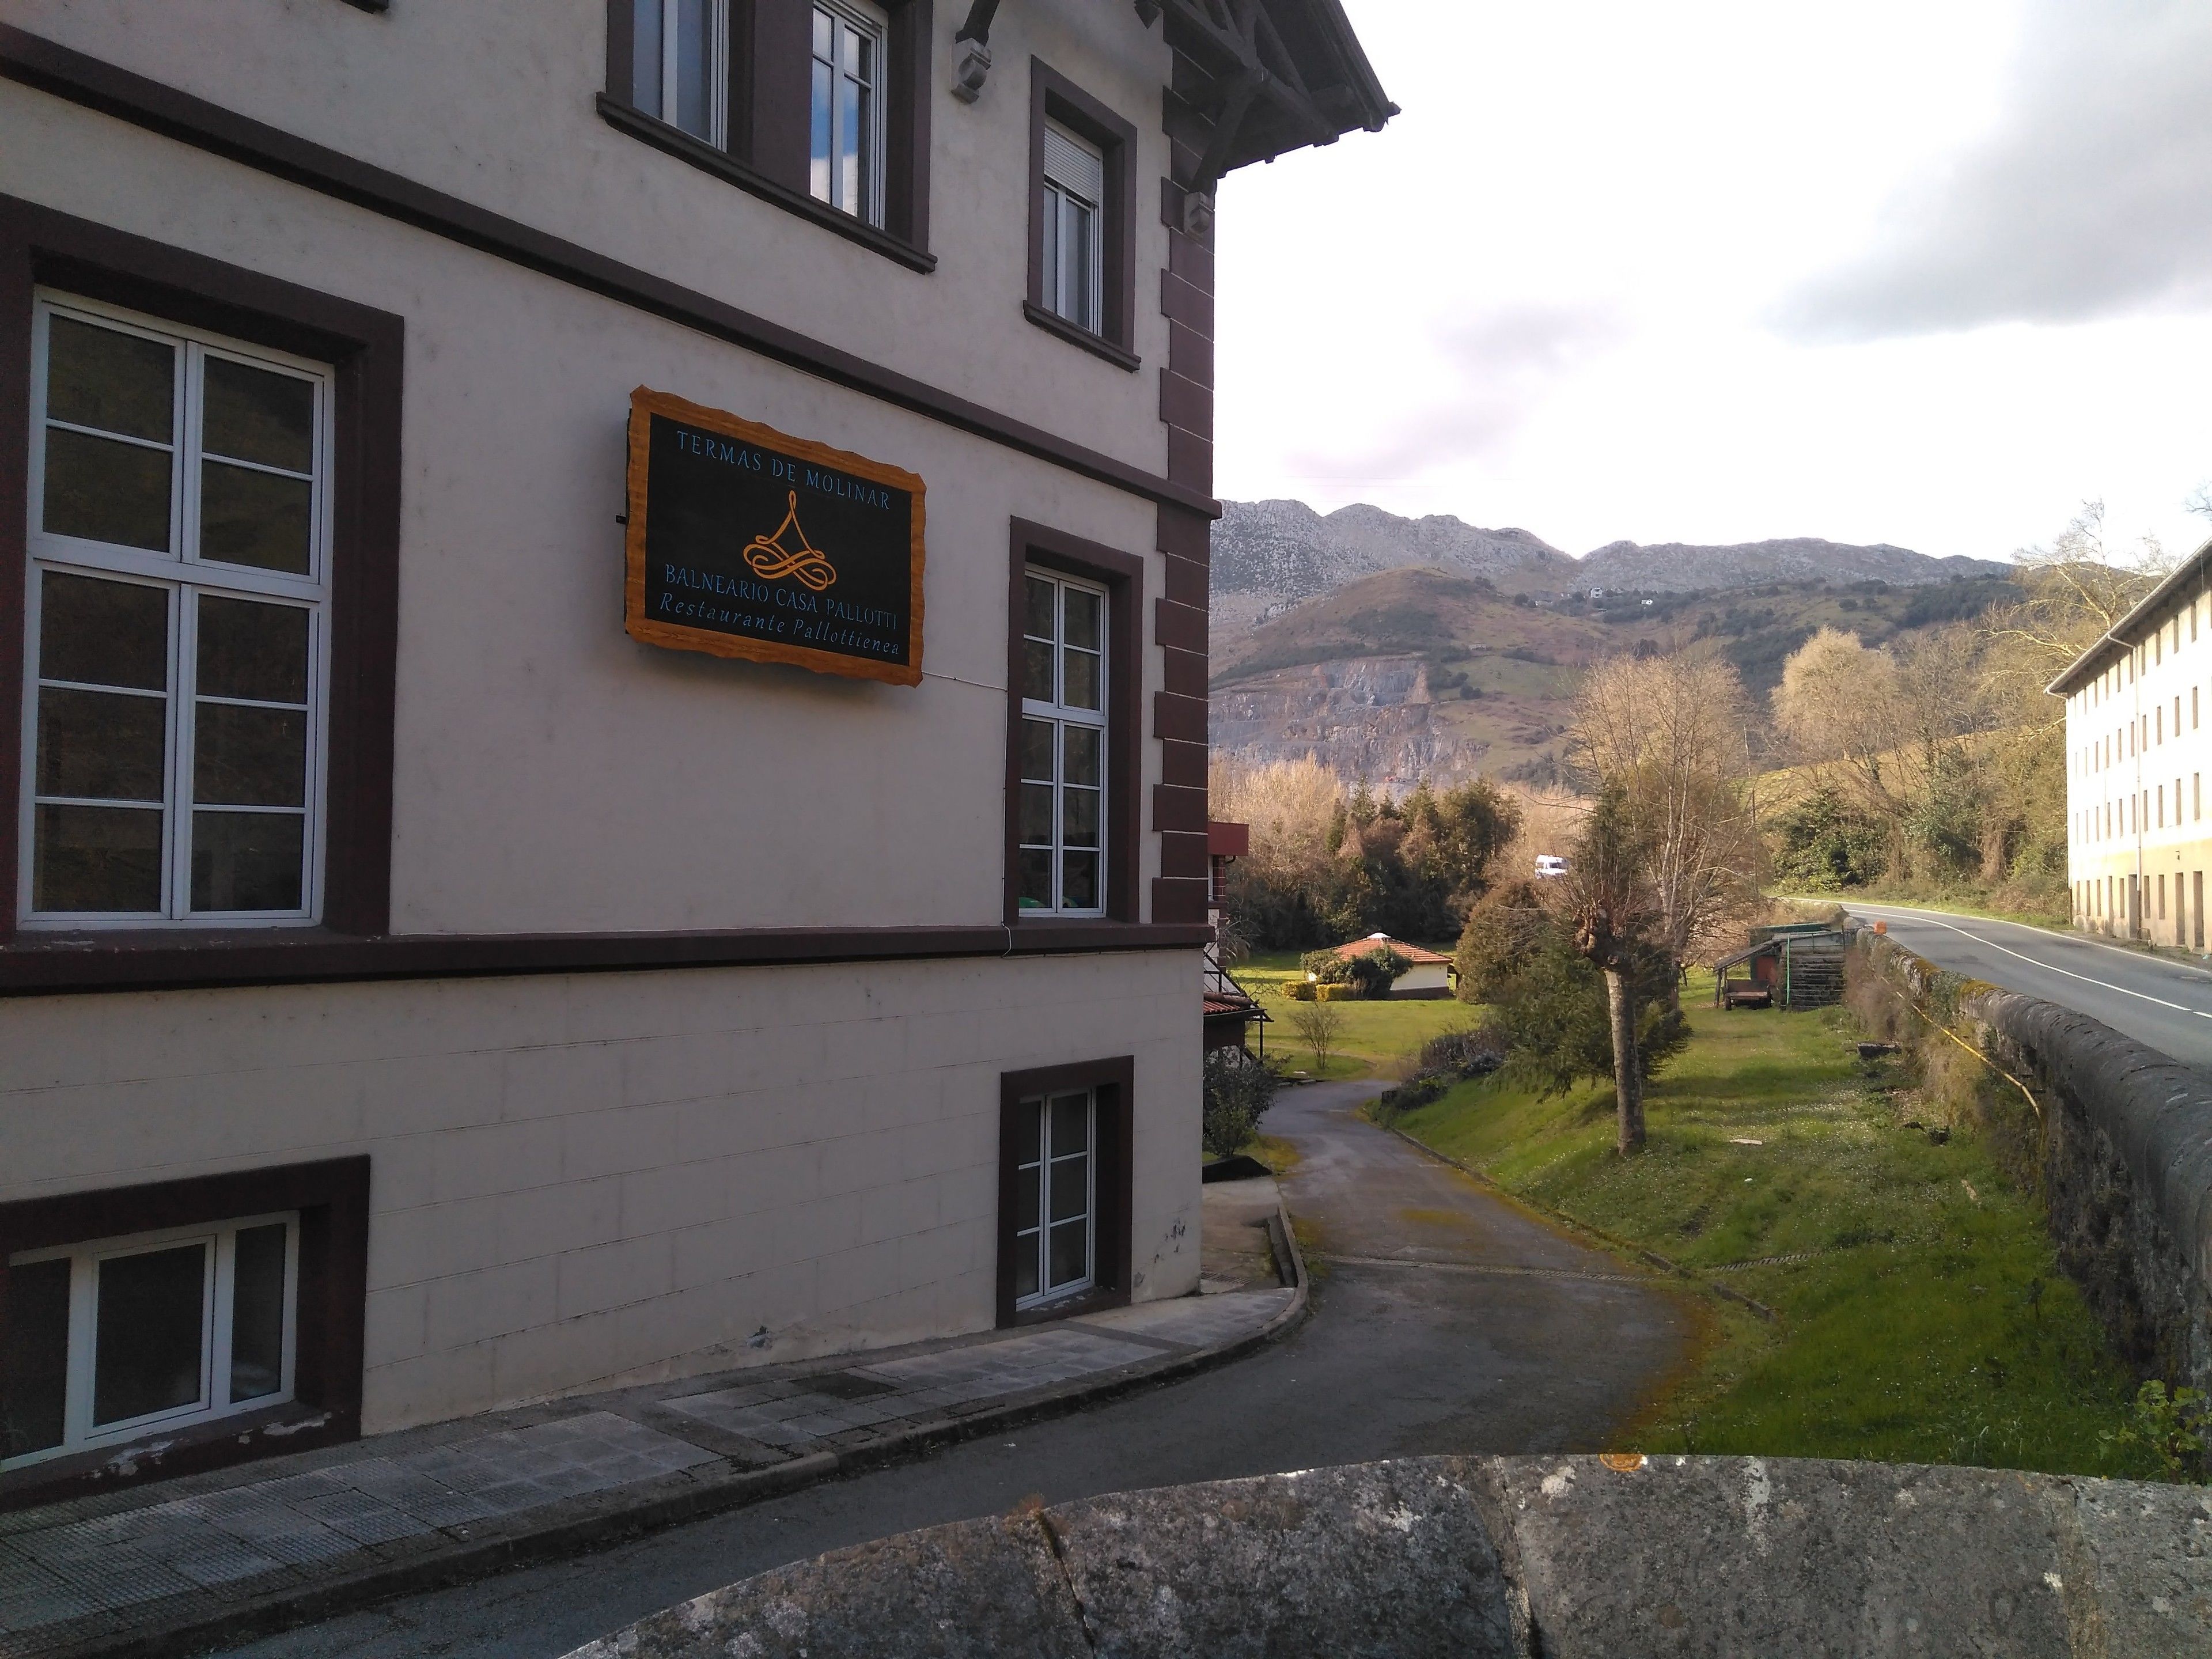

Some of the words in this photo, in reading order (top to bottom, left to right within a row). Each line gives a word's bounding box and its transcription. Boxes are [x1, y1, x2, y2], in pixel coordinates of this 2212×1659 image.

[677, 430, 762, 471] TERMAS
[771, 459, 796, 482] DE
[806, 469, 890, 510] MOLINAR
[660, 593, 785, 634] Restaurante
[665, 564, 768, 603] BALNEARIO
[776, 588, 818, 614] CASA
[826, 599, 897, 630] PALLOTTI
